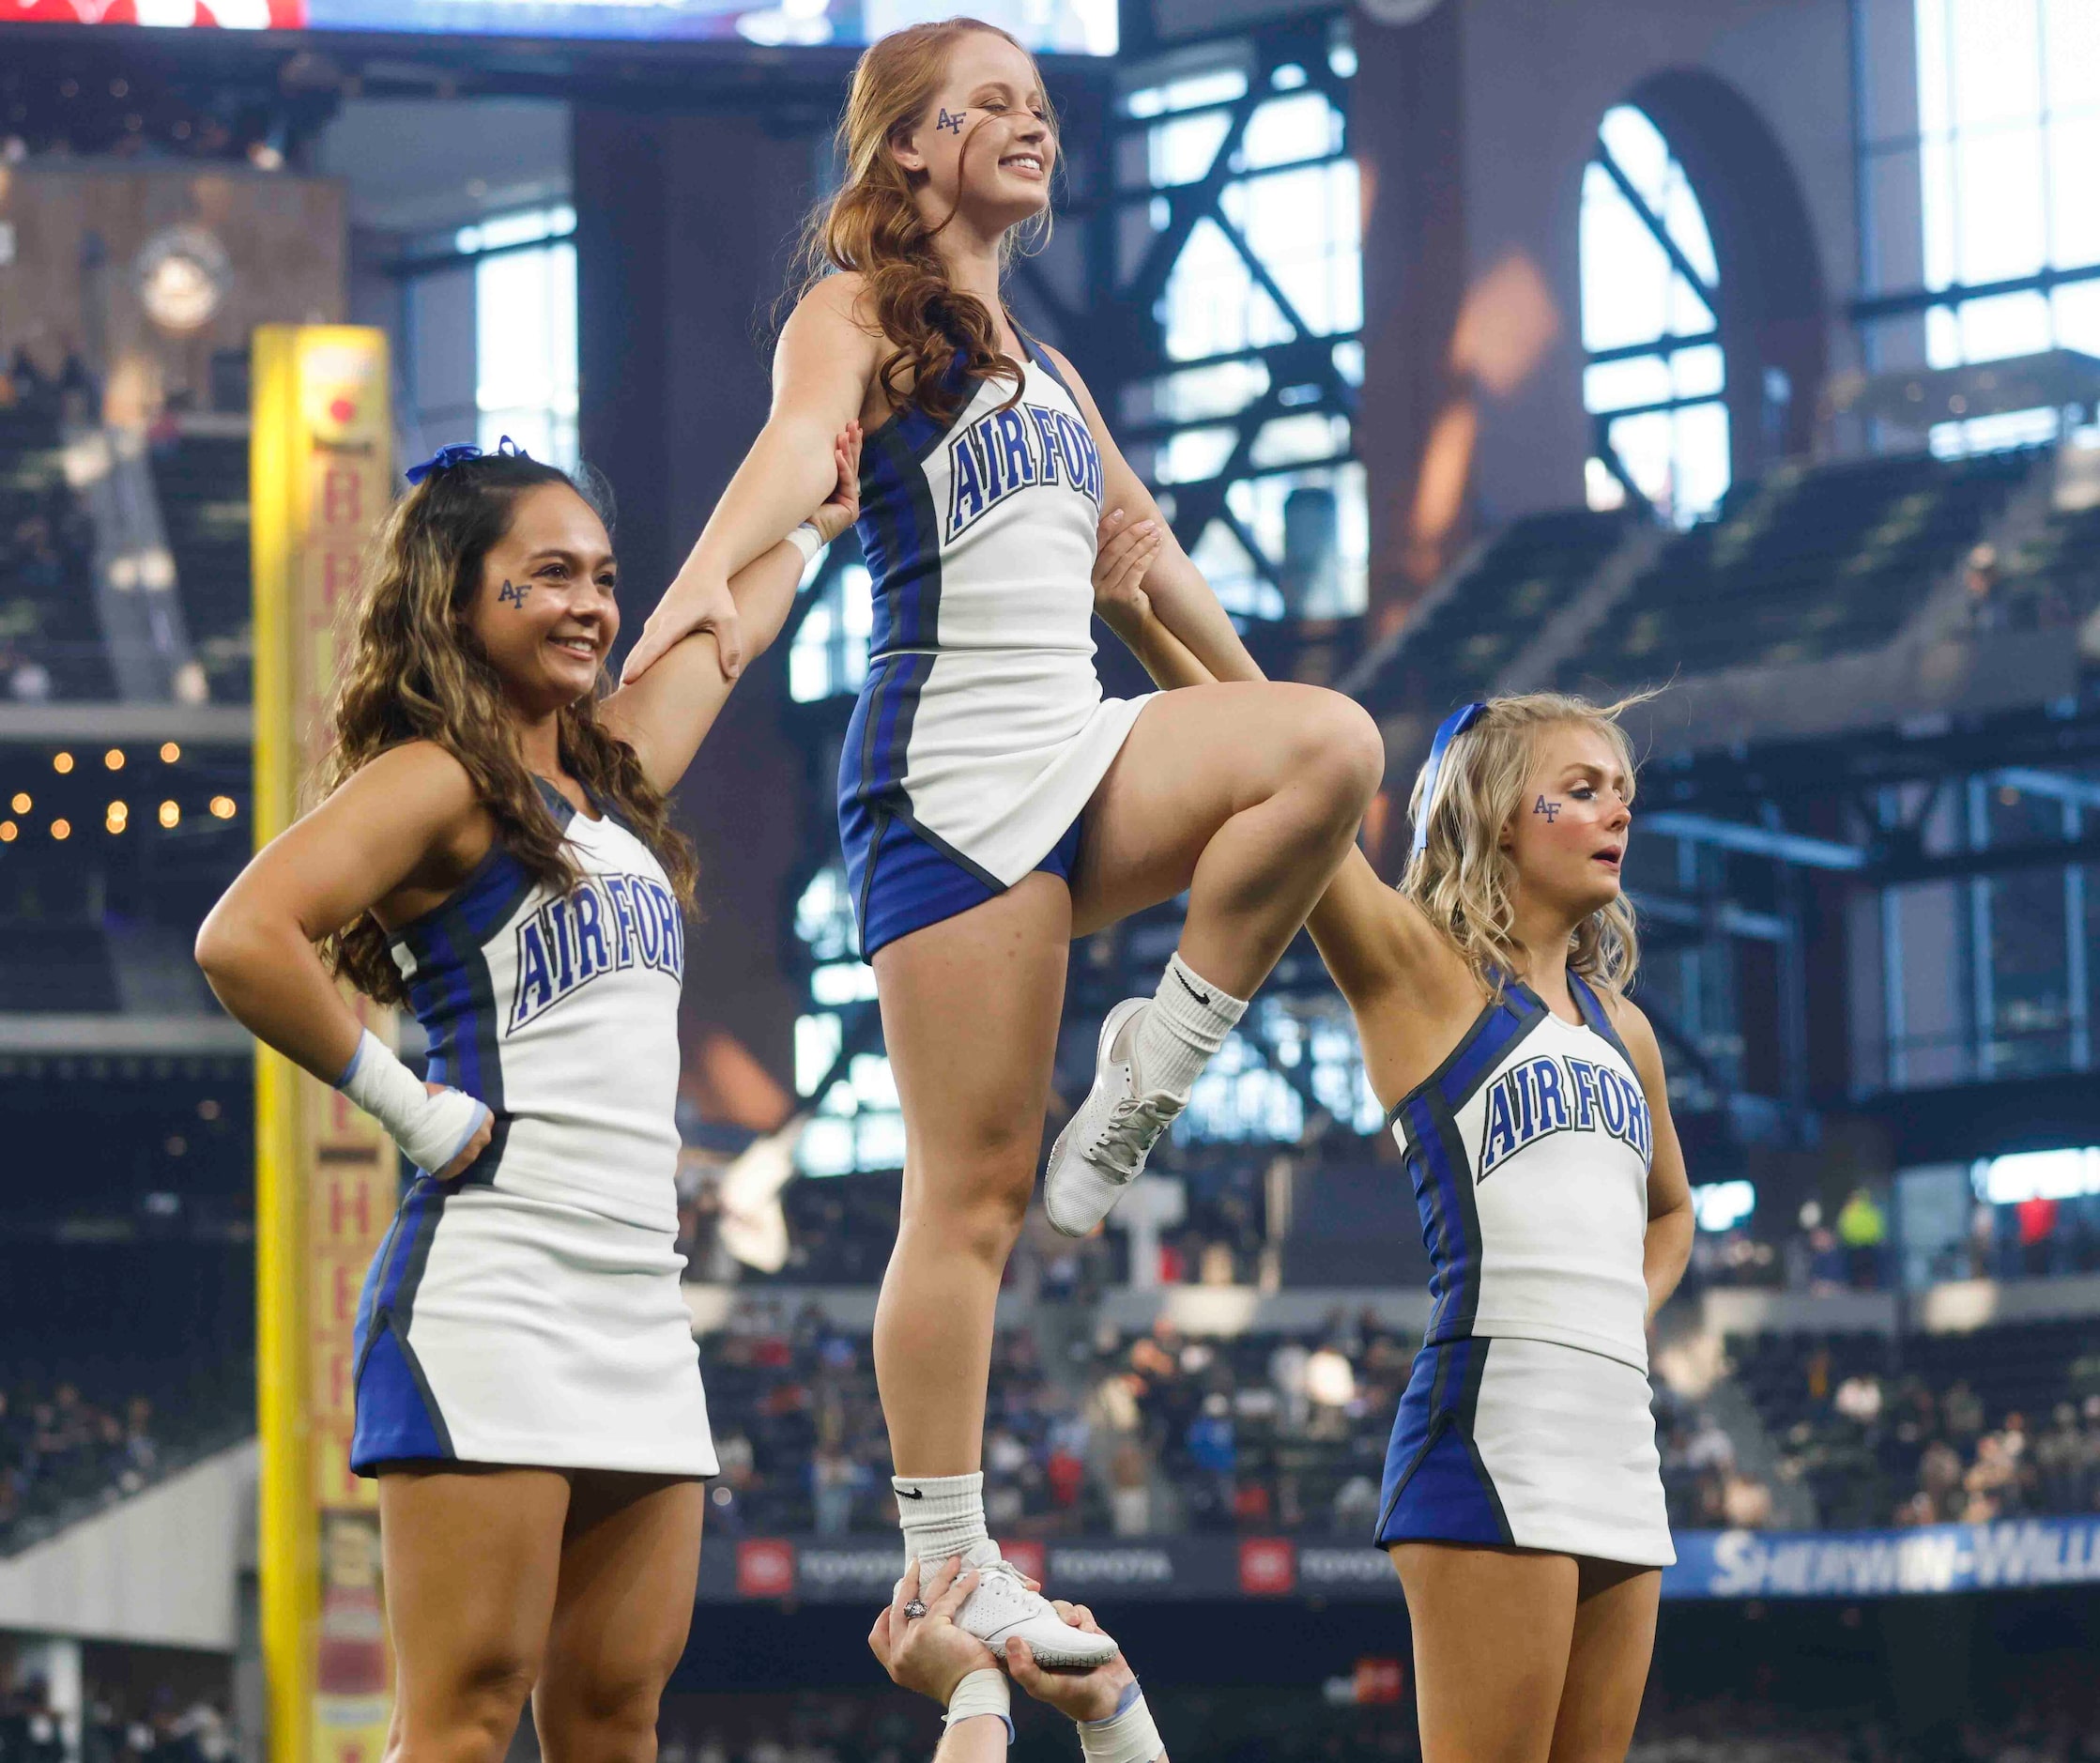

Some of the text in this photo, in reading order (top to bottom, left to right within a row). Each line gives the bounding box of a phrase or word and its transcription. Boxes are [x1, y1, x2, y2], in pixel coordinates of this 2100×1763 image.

[936, 108, 966, 135] AF
[945, 403, 1037, 544] AIR
[498, 578, 532, 609] AF
[1532, 794, 1561, 823] AF
[507, 872, 683, 1036] AIR FOR
[1477, 1055, 1571, 1184] AIR
